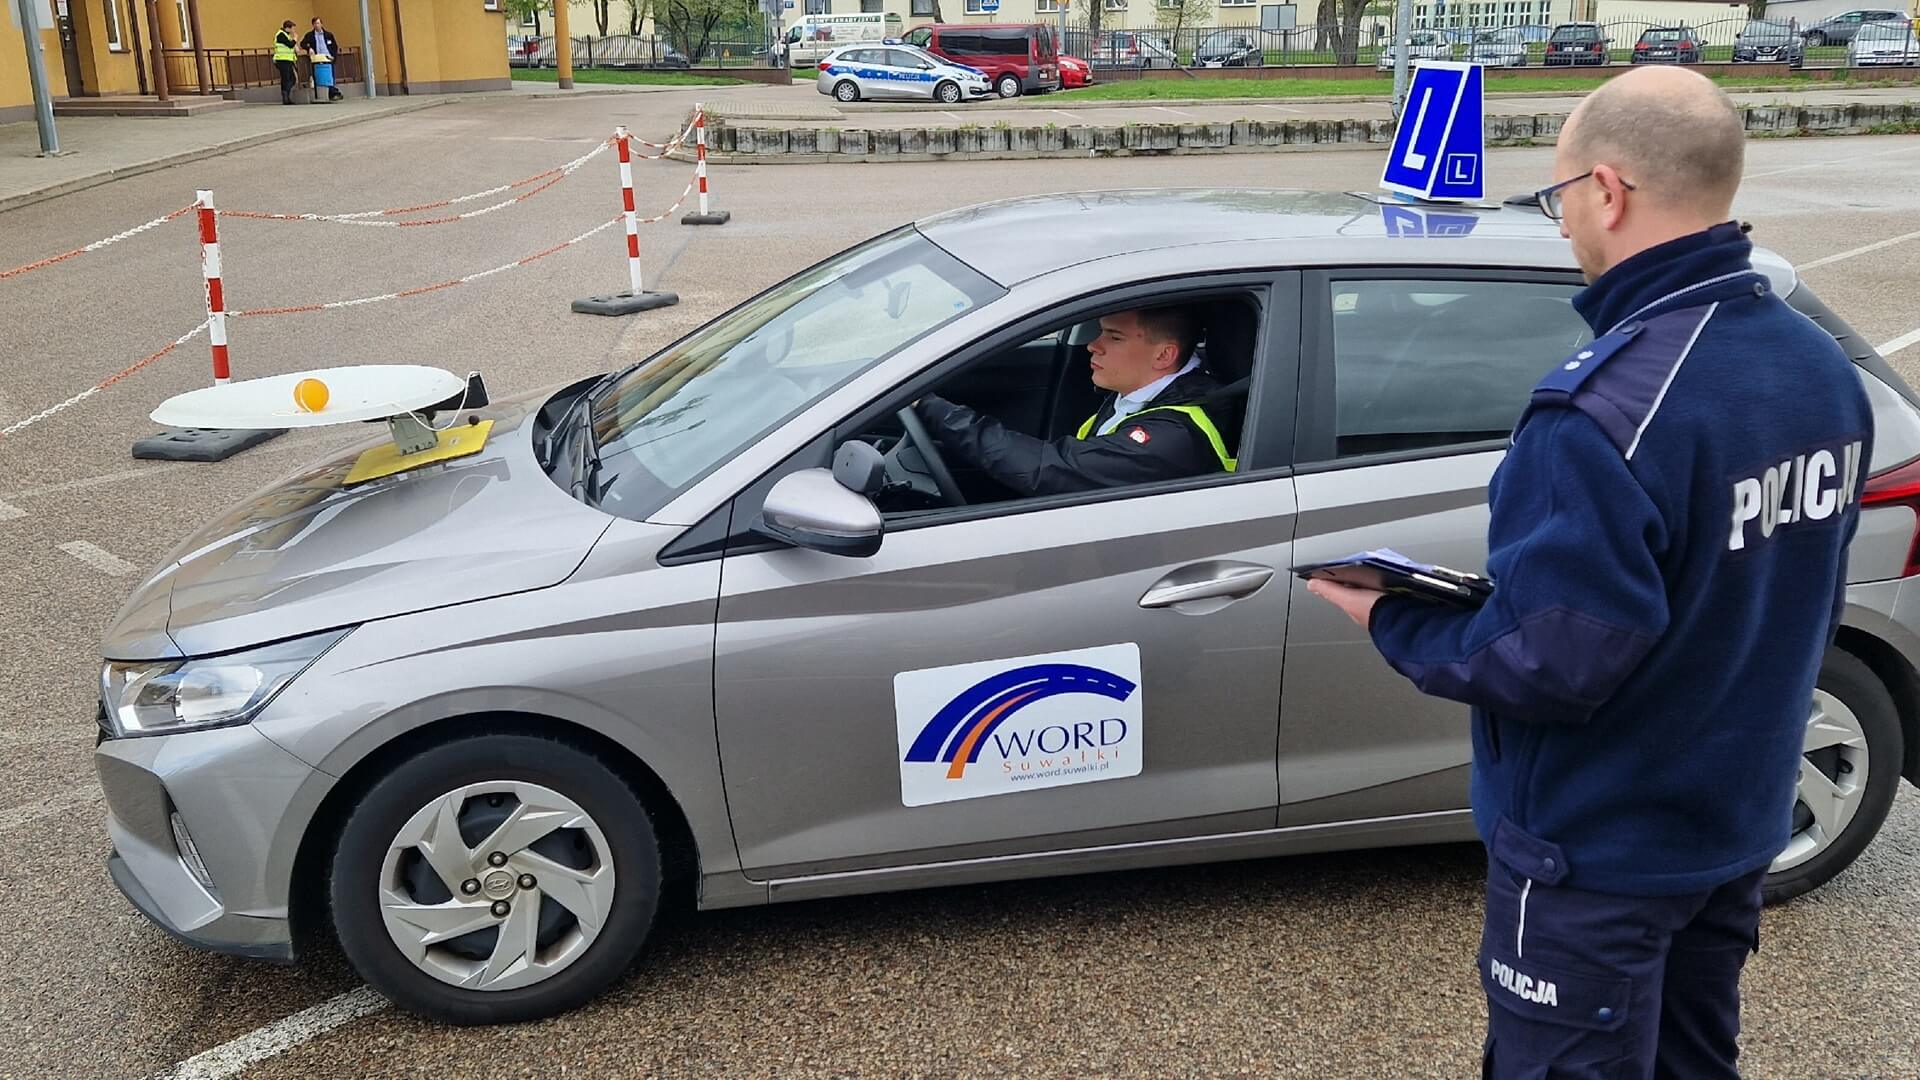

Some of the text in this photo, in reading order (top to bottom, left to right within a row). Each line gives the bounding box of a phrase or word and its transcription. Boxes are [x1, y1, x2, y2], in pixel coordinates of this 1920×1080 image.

[1403, 87, 1433, 170] L
[1455, 159, 1468, 178] L
[994, 718, 1127, 759] WORD
[1010, 761, 1110, 782] www.word.suwalki.pl
[1490, 958, 1558, 1007] POLICJA
